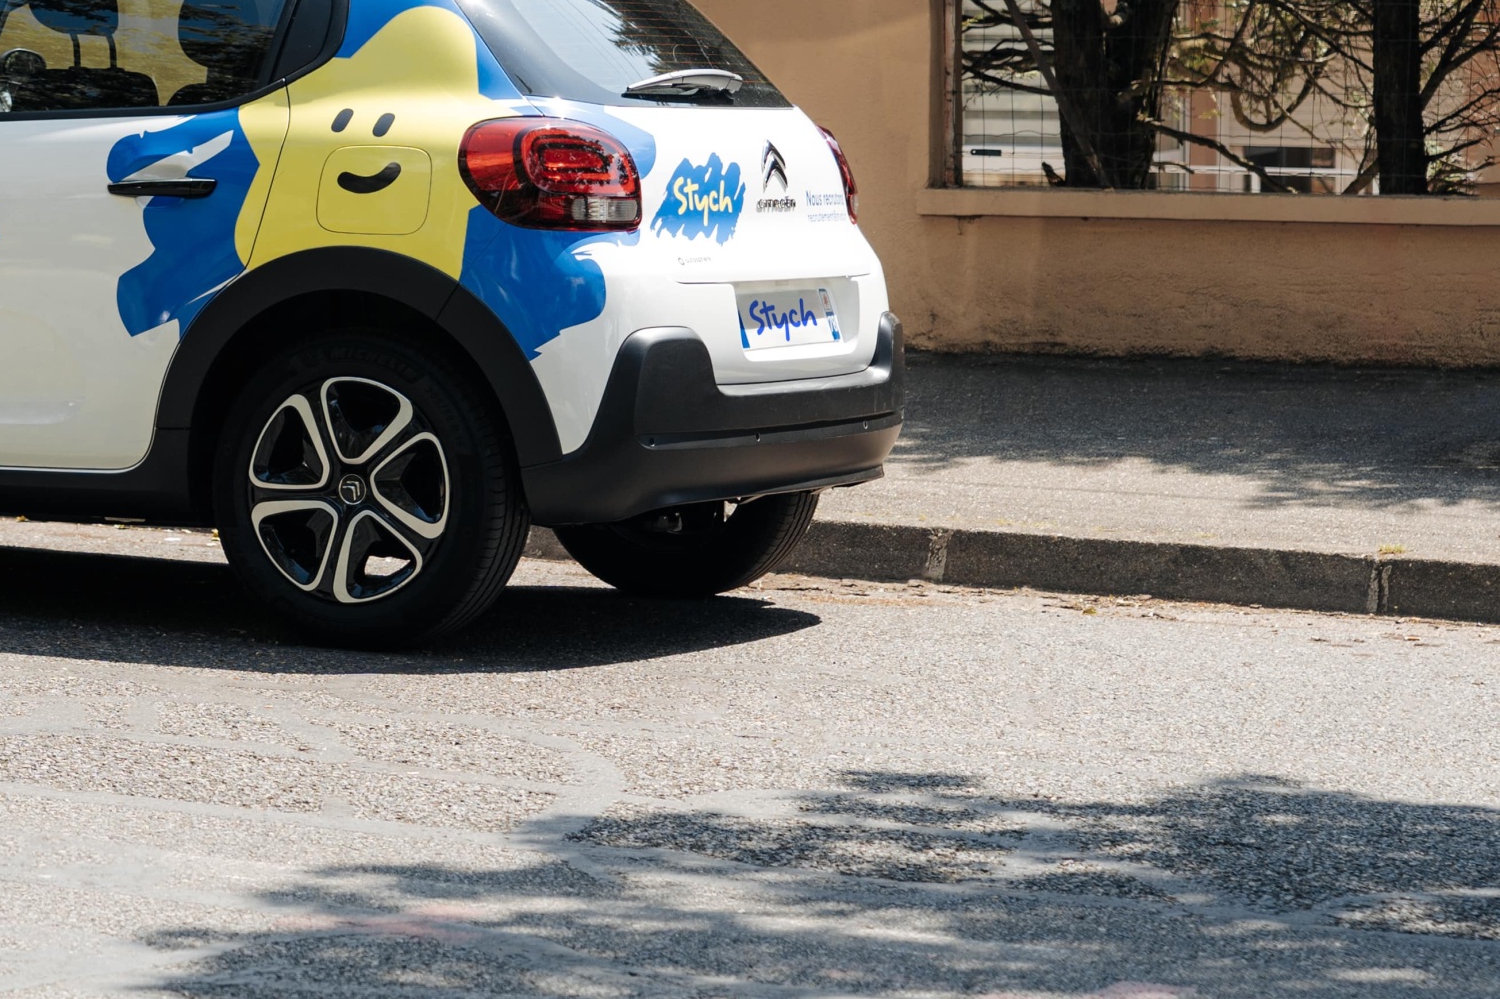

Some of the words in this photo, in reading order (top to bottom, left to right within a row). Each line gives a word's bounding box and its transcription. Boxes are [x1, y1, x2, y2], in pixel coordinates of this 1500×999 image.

[673, 176, 733, 227] Stych
[805, 189, 822, 206] Nous
[749, 298, 818, 342] Stych
